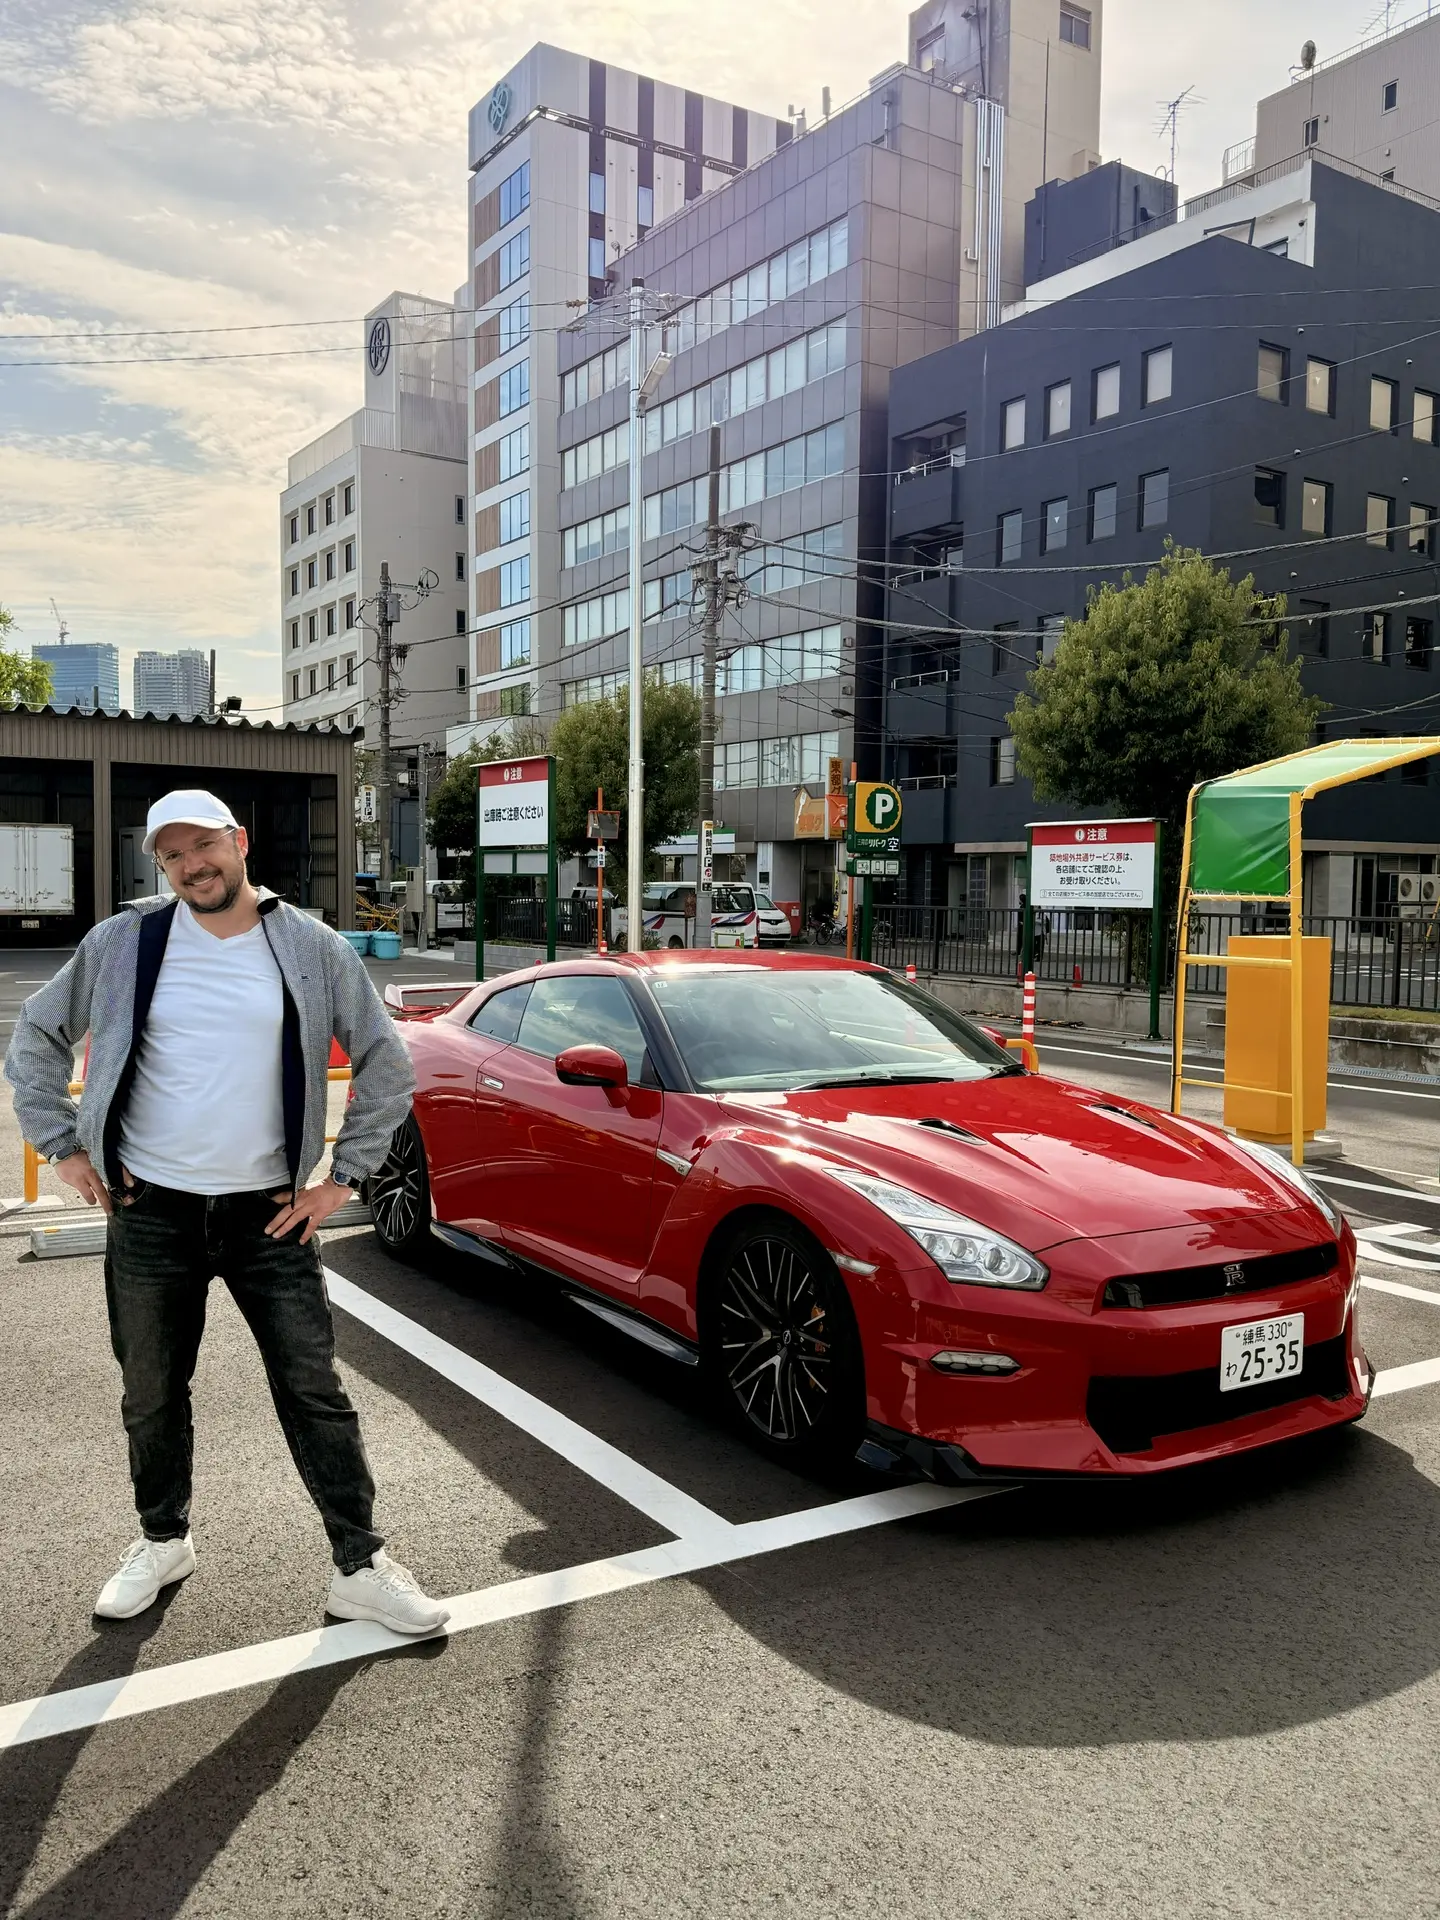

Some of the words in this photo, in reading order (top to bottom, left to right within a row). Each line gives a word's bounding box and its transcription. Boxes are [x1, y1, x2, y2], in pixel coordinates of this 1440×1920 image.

[510, 767, 523, 780] 注意
[484, 805, 544, 823] 出庫時ご注意ください
[875, 793, 894, 824] P
[1087, 828, 1108, 841] 注意
[887, 837, 899, 851] 空
[1049, 852, 1133, 862] 築地場外共通サービス券は、
[1056, 865, 1126, 874] 各店舗にてご確認の上、
[1060, 876, 1121, 885] お受け取りください。
[1242, 1325, 1266, 1346] 練馬
[1267, 1321, 1287, 1341] 330
[1226, 1361, 1238, 1377] わ
[1240, 1340, 1300, 1383] 25-35
